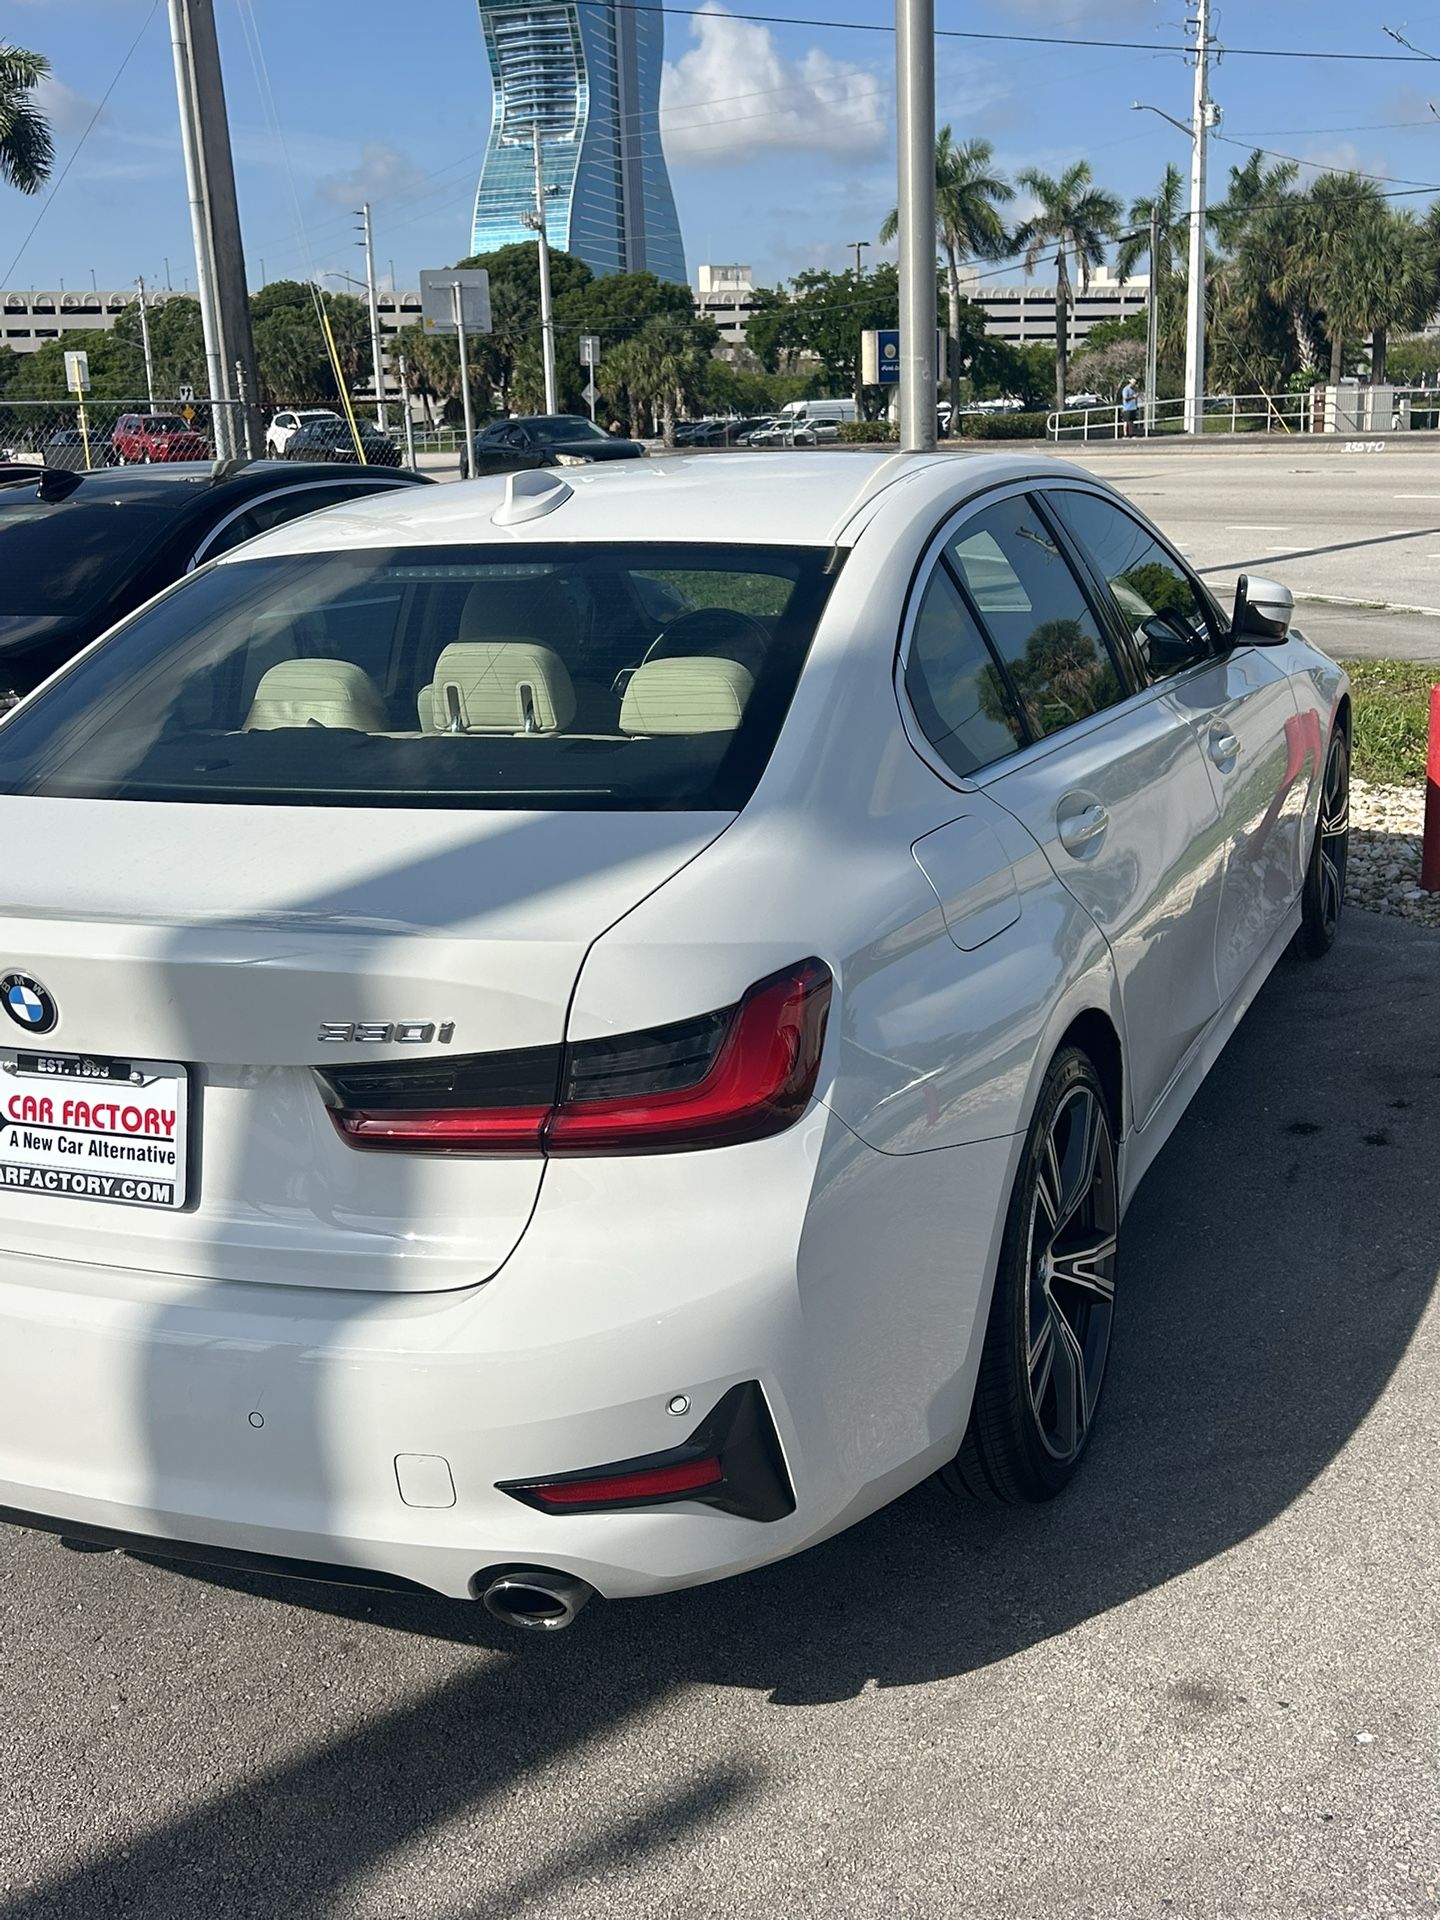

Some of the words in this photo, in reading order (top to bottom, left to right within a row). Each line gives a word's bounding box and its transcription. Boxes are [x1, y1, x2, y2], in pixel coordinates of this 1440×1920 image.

[1, 975, 45, 996] BMW
[317, 1021, 456, 1044] 330i
[37, 1058, 69, 1073] EST.
[74, 1062, 110, 1077] 1993
[8, 1095, 53, 1123] CAR
[63, 1100, 176, 1135] FACTORY
[9, 1130, 19, 1147] A
[23, 1131, 53, 1151] New
[57, 1135, 83, 1155] Car
[88, 1140, 176, 1165] Alternative
